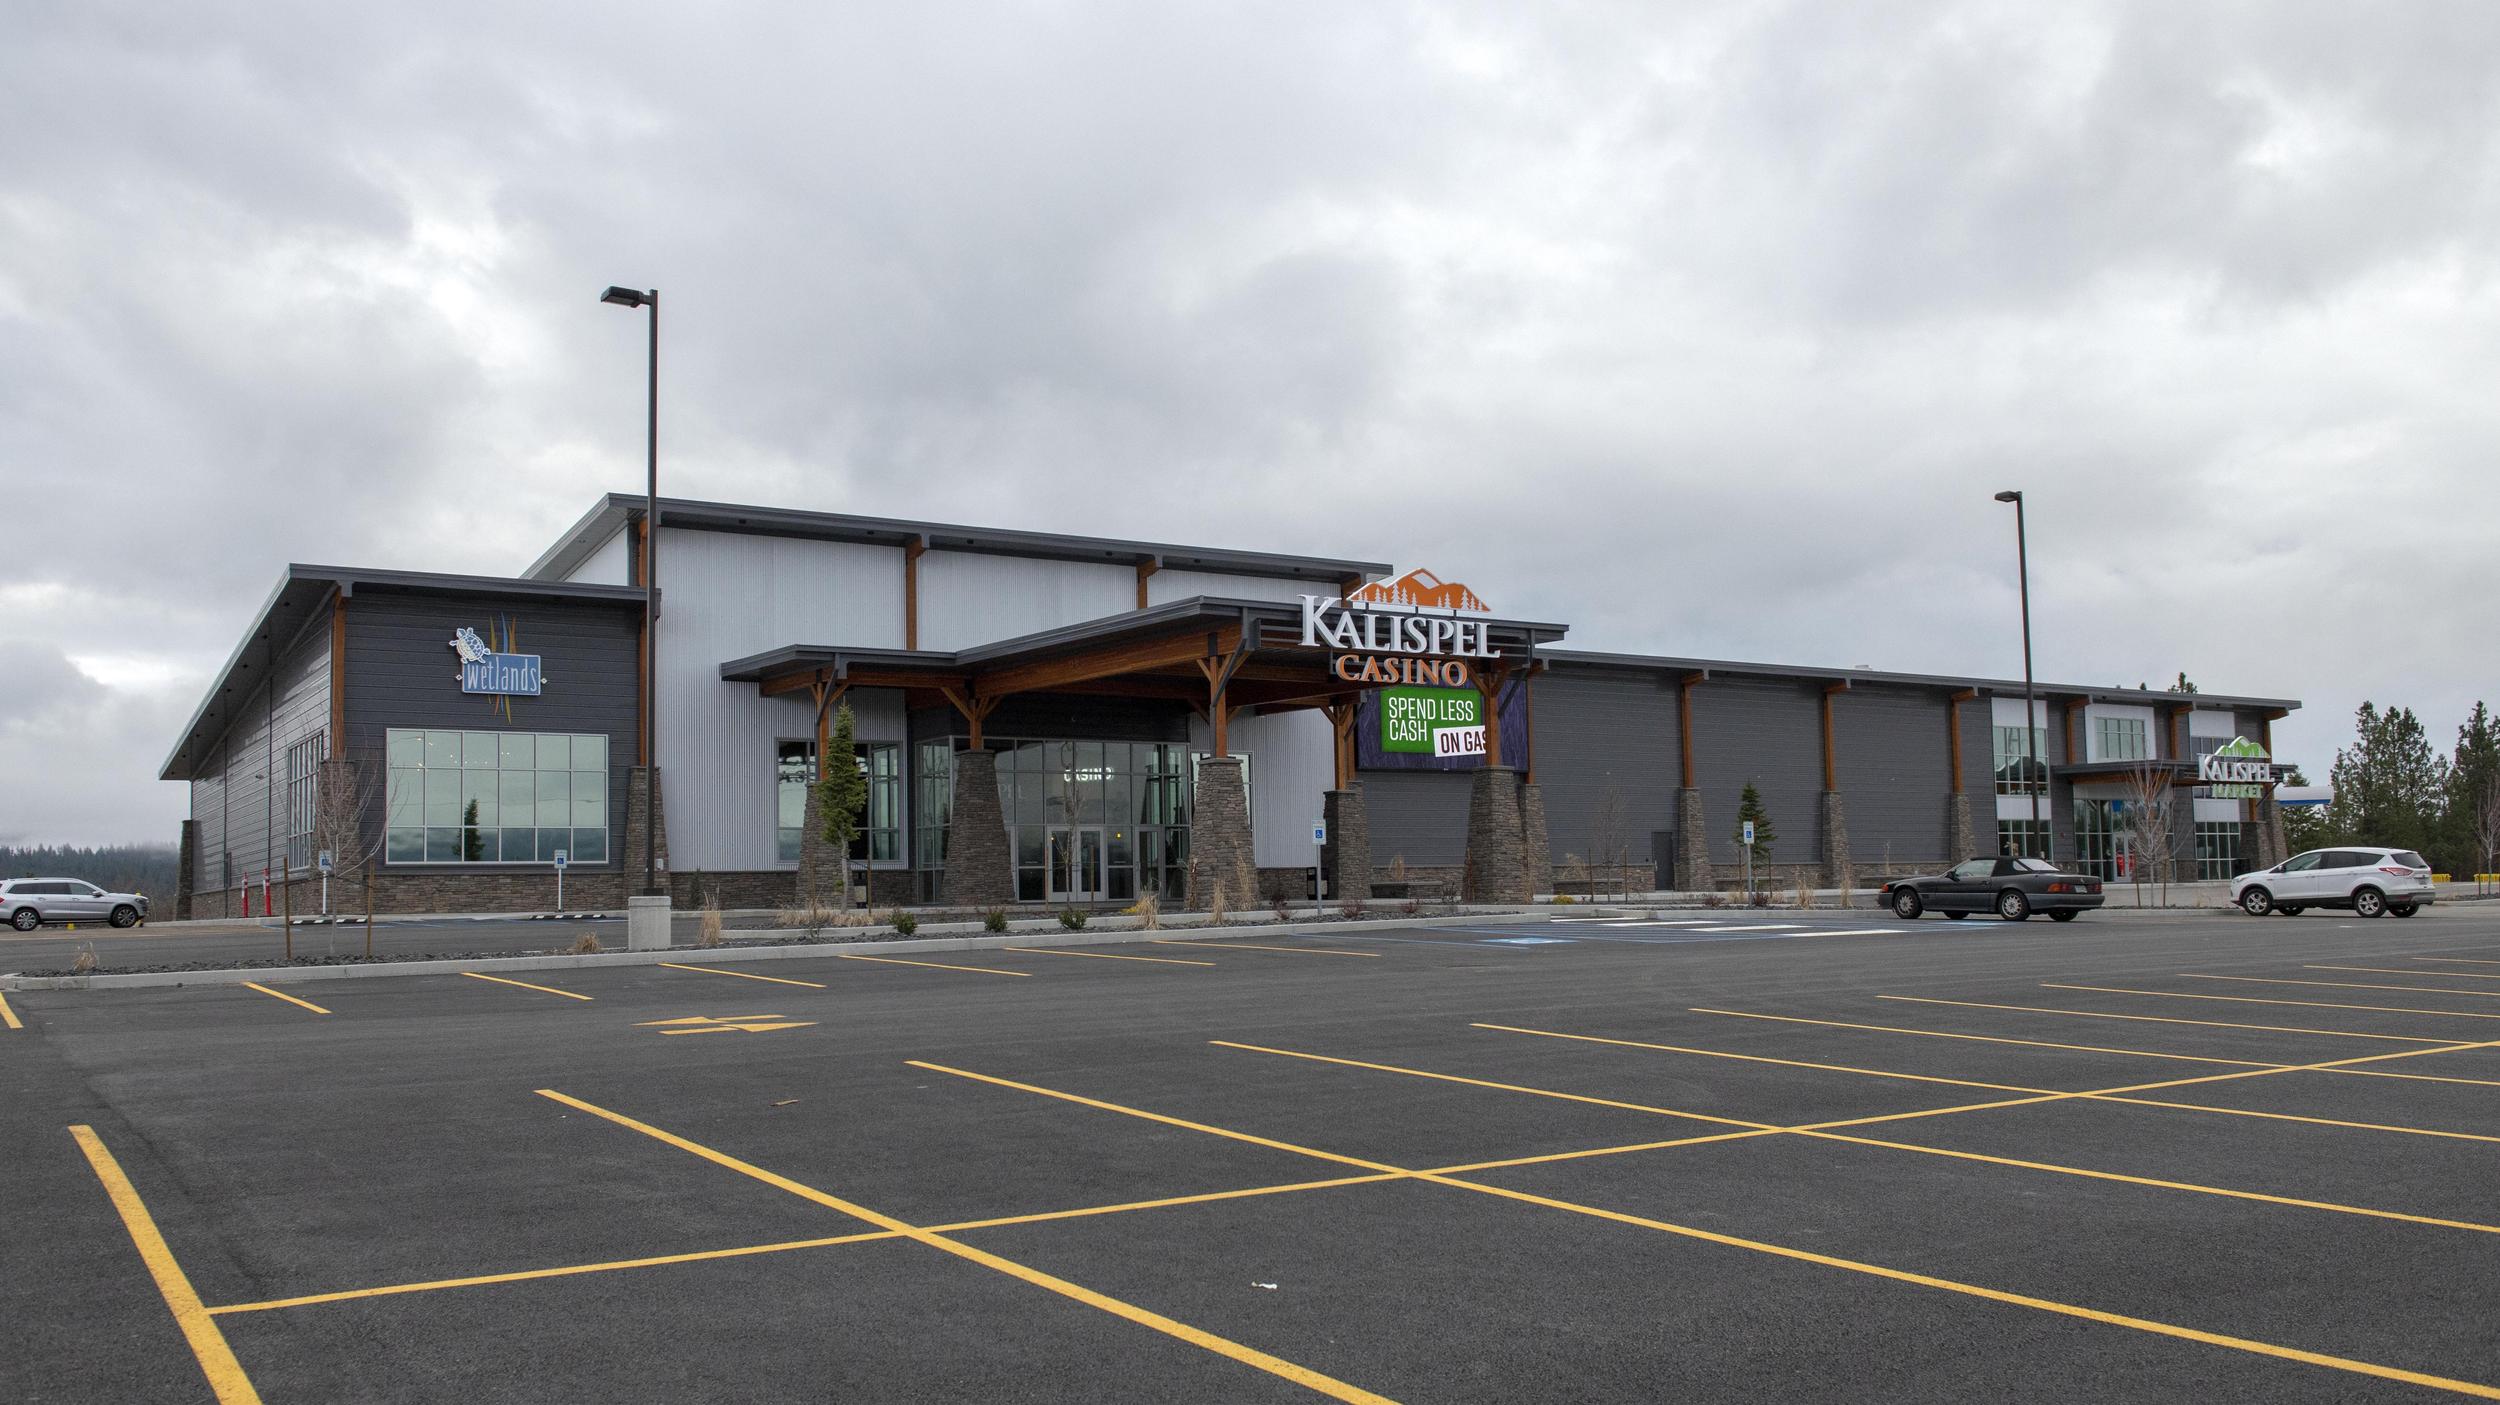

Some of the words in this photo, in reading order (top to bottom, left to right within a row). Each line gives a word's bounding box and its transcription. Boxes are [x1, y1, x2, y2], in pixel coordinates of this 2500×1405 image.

[1297, 594, 1500, 658] KALISPEL
[467, 656, 537, 692] wetlands
[1335, 654, 1468, 687] CASINO
[1388, 697, 1436, 720] SPEND
[1440, 699, 1474, 721] LESS
[1389, 719, 1428, 742] CASH
[1440, 732, 1460, 753] ON
[2197, 753, 2275, 783] KALISPEL
[2211, 783, 2264, 799] MARKET
